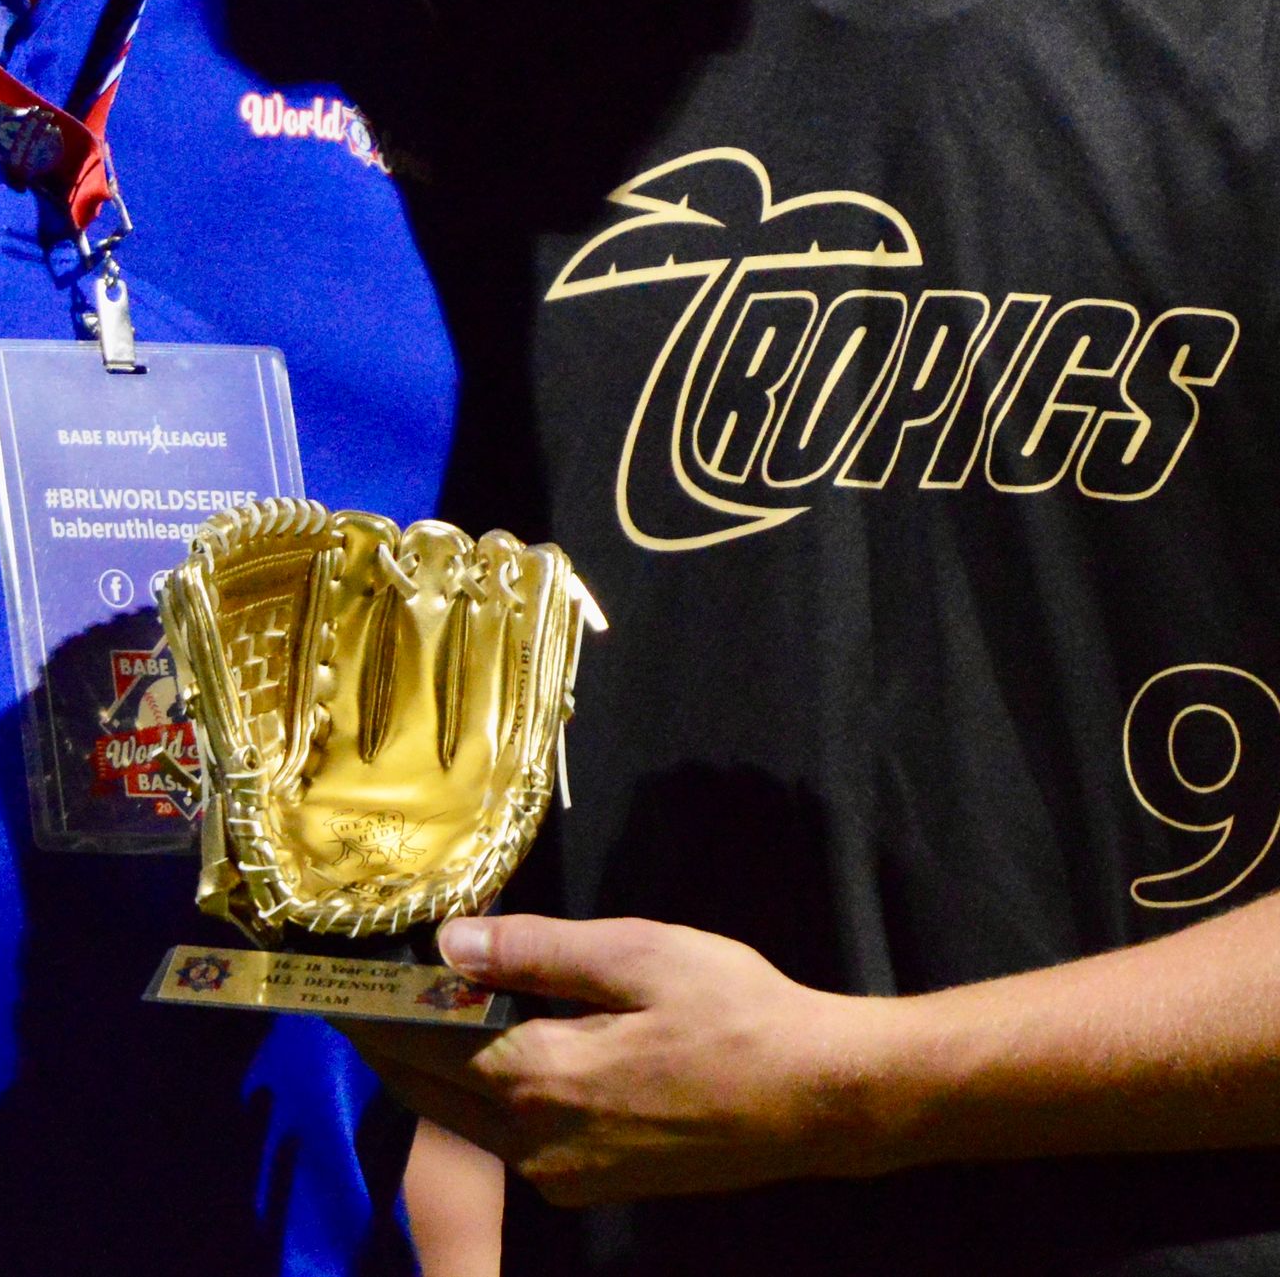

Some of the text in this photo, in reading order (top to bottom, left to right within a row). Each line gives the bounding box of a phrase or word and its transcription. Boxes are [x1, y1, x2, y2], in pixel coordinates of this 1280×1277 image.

[240, 92, 345, 141] World
[57, 429, 227, 447] BABE RUTH LEAGUE
[120, 658, 170, 675] BABE
[106, 730, 184, 769] World
[340, 812, 399, 831] HEART
[262, 974, 401, 993] ALL DEFENSIVE
[300, 992, 350, 1005] TEAM
